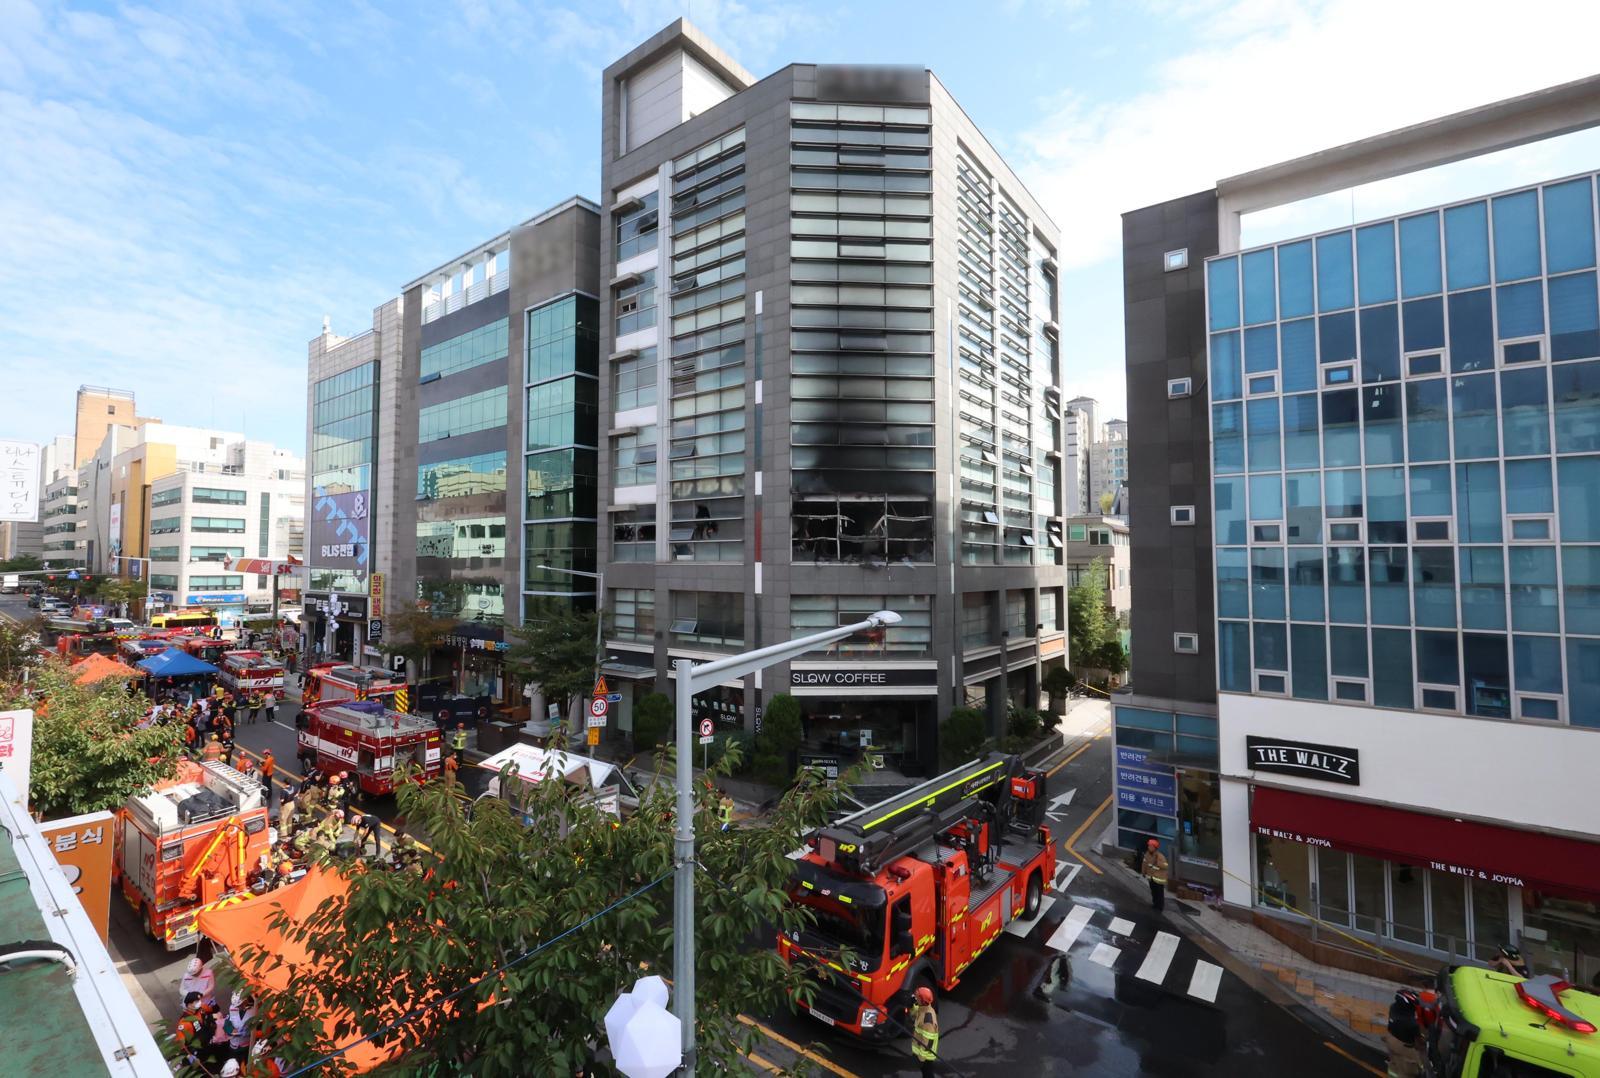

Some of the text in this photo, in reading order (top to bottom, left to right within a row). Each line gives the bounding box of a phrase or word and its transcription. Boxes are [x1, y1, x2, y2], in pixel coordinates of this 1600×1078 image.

[277, 564, 293, 574] SK
[393, 655, 405, 670] P
[254, 677, 271, 686] 119
[792, 672, 886, 684] SLOW COFFEE
[593, 702, 605, 712] 50
[720, 713, 737, 722] SLOW
[1257, 748, 1288, 762] THE
[1120, 792, 1136, 802] 미용
[1258, 827, 1271, 836] THE
[838, 843, 856, 853] 119
[144, 853, 155, 870] 119
[1430, 861, 1446, 871] THE
[1478, 871, 1487, 880] &
[980, 911, 993, 933] 119
